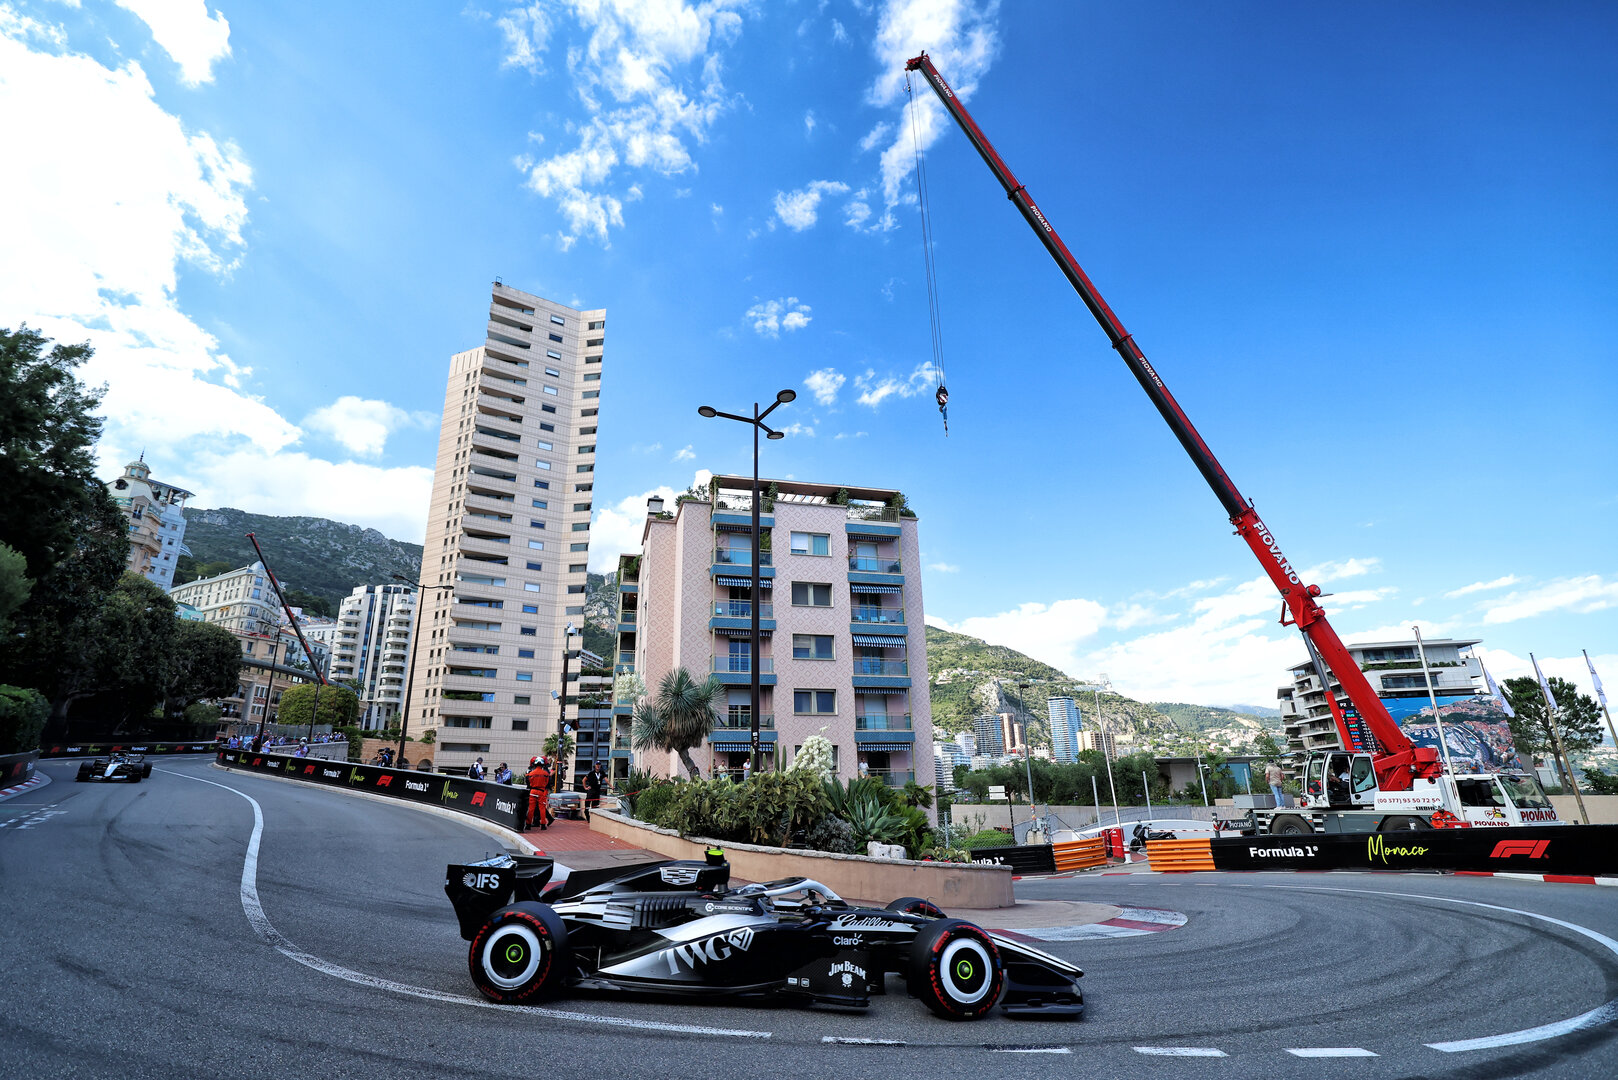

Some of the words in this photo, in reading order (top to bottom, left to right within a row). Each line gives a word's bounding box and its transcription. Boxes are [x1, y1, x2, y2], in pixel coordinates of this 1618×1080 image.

[1030, 205, 1052, 232] PIOVANO
[1139, 356, 1163, 388] PIOVANO
[1253, 521, 1300, 585] PIOVANO
[1520, 810, 1556, 821] PIOVANO
[1249, 846, 1304, 857] Formula
[1368, 834, 1429, 864] Monaco
[1489, 840, 1551, 858] F1
[476, 873, 500, 889] IFS
[837, 914, 894, 927] Cadillac
[833, 934, 861, 946] Claro
[658, 934, 732, 975] TWG
[828, 962, 844, 976] JIM
[844, 960, 866, 980] BEAM
